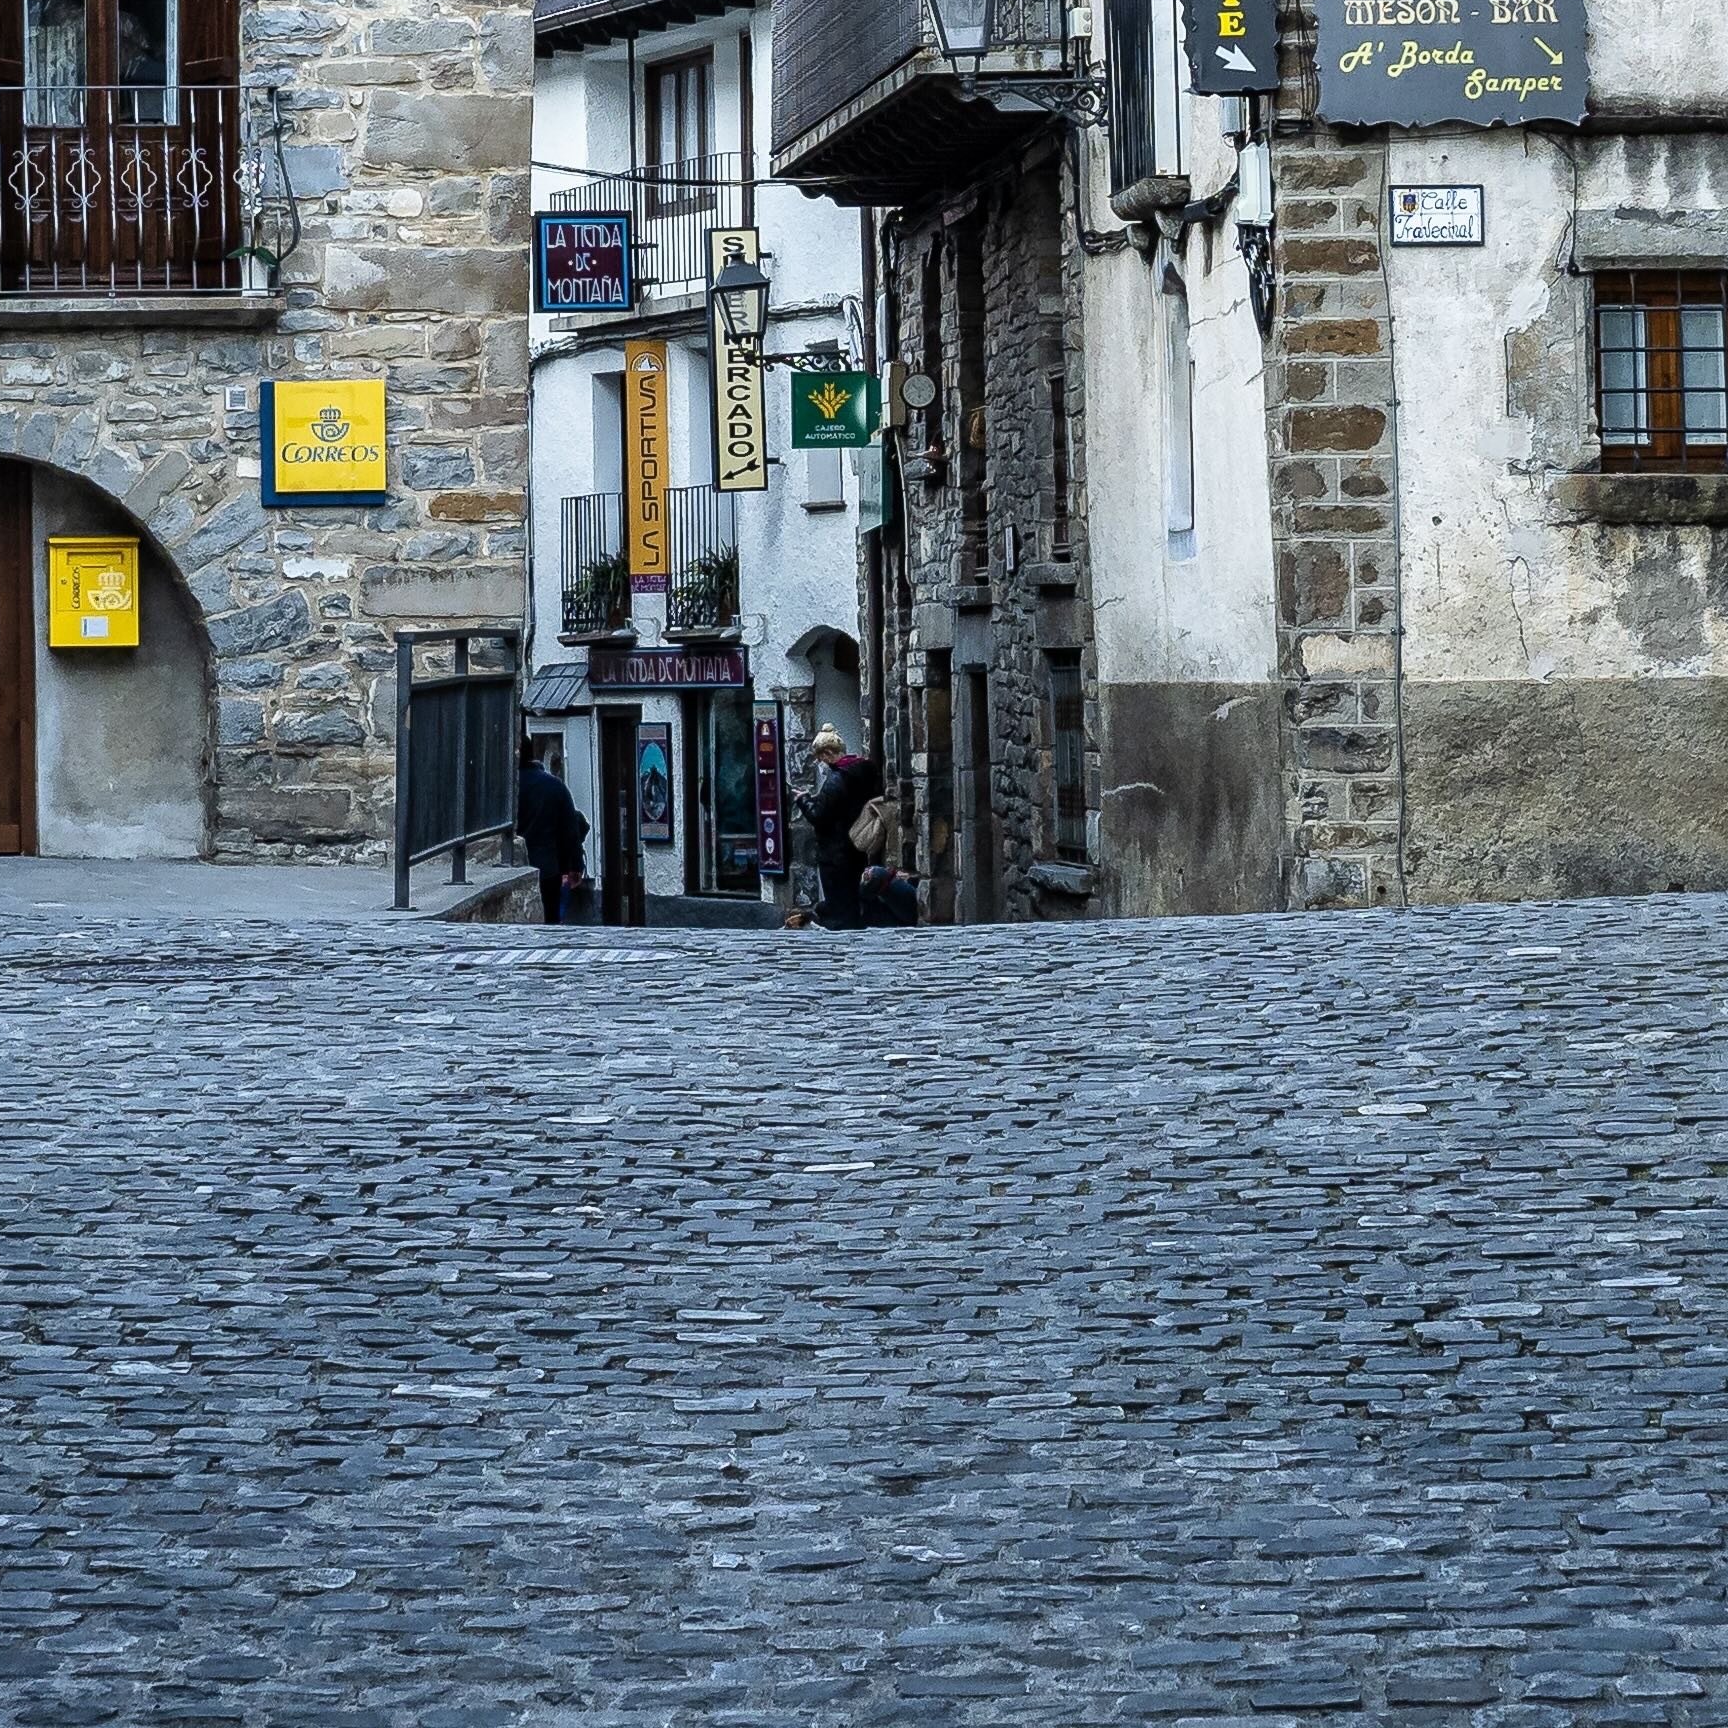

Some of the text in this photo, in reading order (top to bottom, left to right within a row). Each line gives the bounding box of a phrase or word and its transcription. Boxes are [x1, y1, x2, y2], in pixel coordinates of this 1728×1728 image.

[1387, 40, 1475, 78] Borda
[1464, 68, 1563, 103] Samper
[1421, 191, 1468, 210] Calle
[546, 224, 623, 249] LA TIENDA
[575, 253, 591, 272] DE
[547, 275, 624, 304] MONTAÑA
[814, 424, 846, 432] CAJERO
[281, 442, 380, 464] CORREOS
[639, 374, 660, 567] LA SPORTIVA
[658, 656, 673, 683] DE
